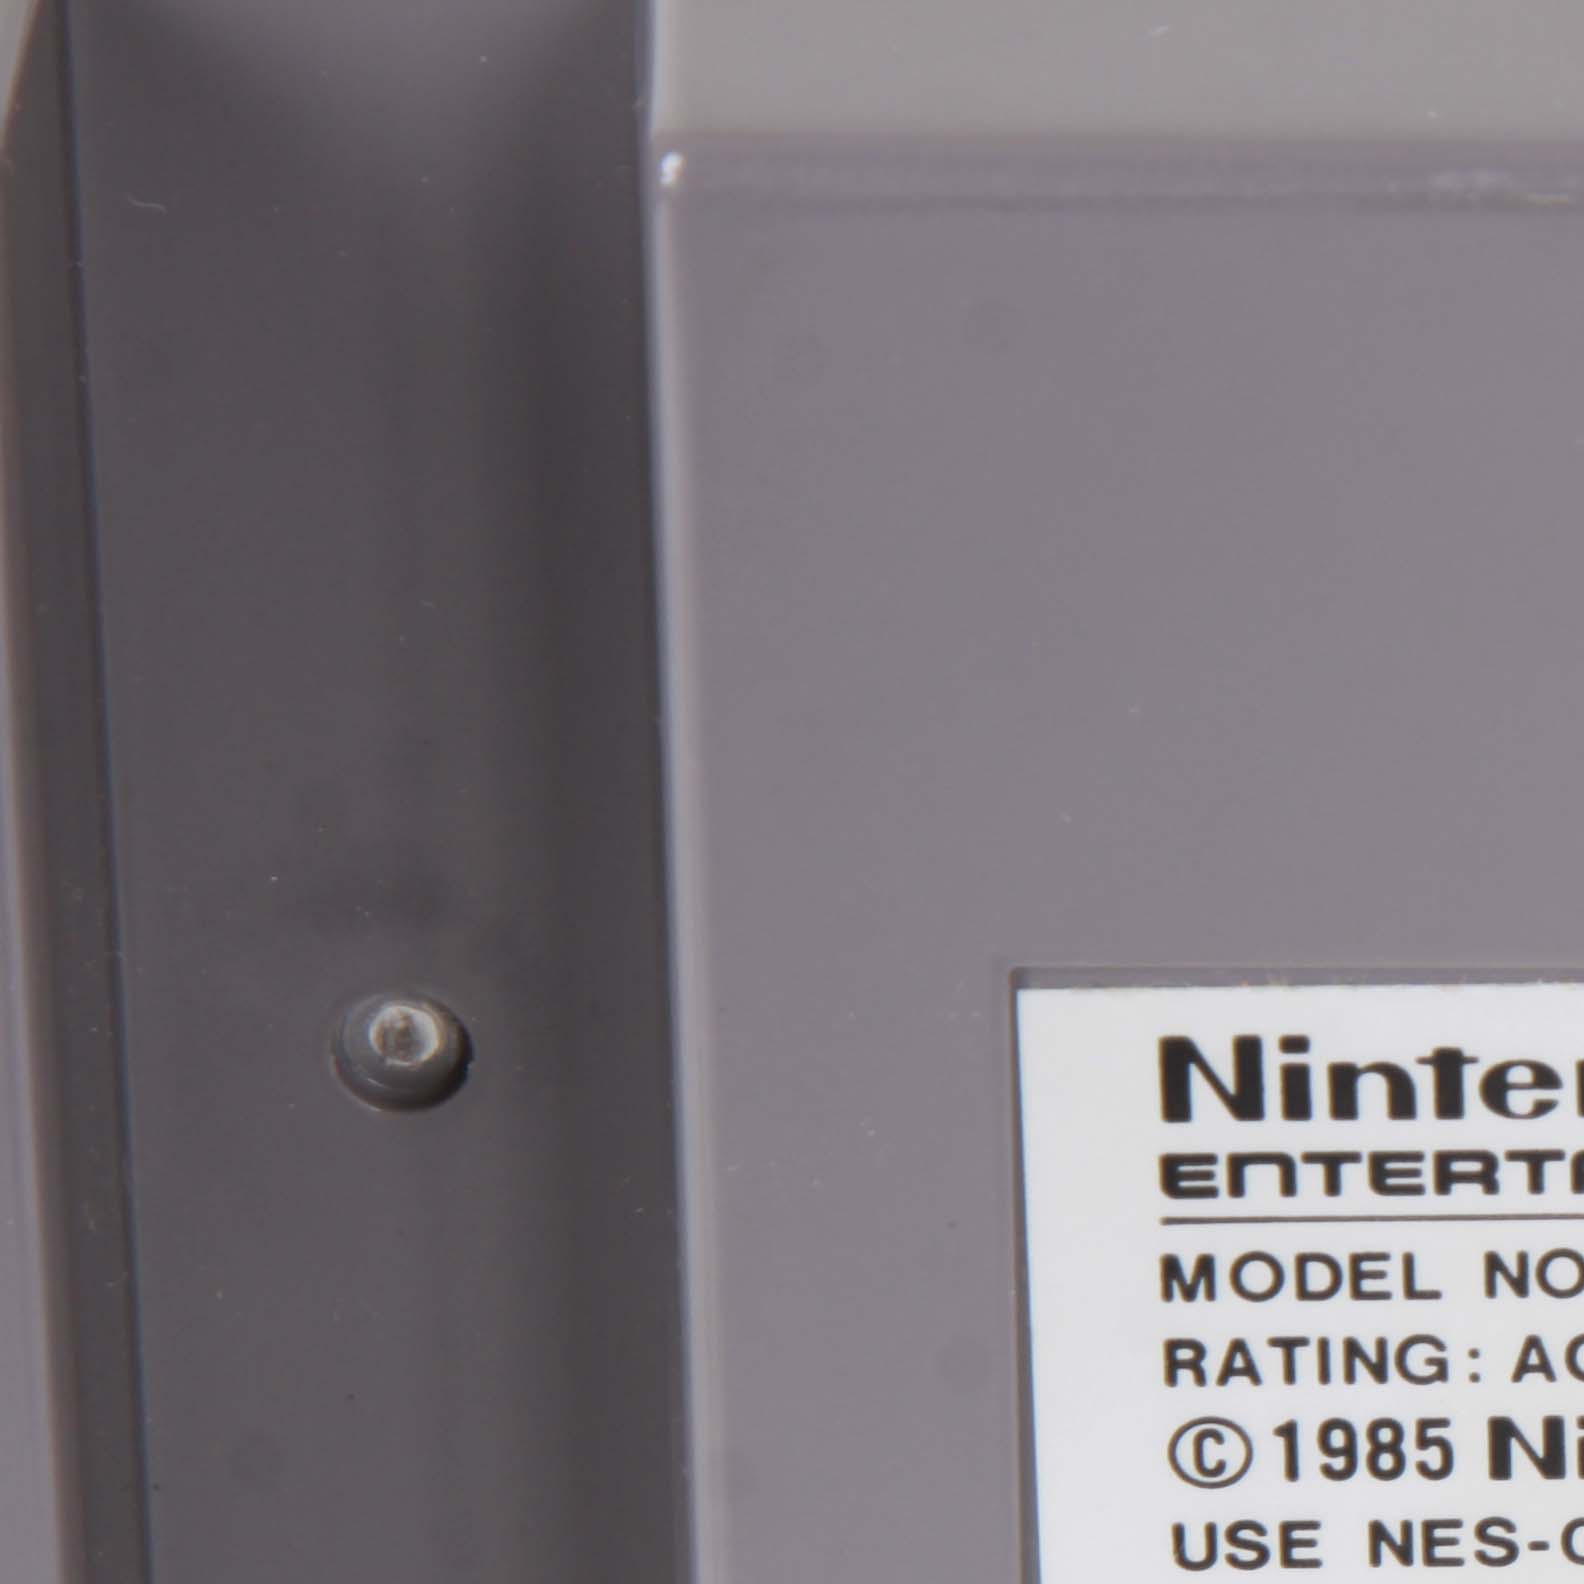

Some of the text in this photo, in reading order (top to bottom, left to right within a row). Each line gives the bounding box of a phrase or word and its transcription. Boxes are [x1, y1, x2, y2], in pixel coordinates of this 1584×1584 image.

[1161, 1252, 1442, 1303] MODEL
[1164, 1337, 1481, 1387] RATING:
[1172, 1520, 1322, 1571] USE
